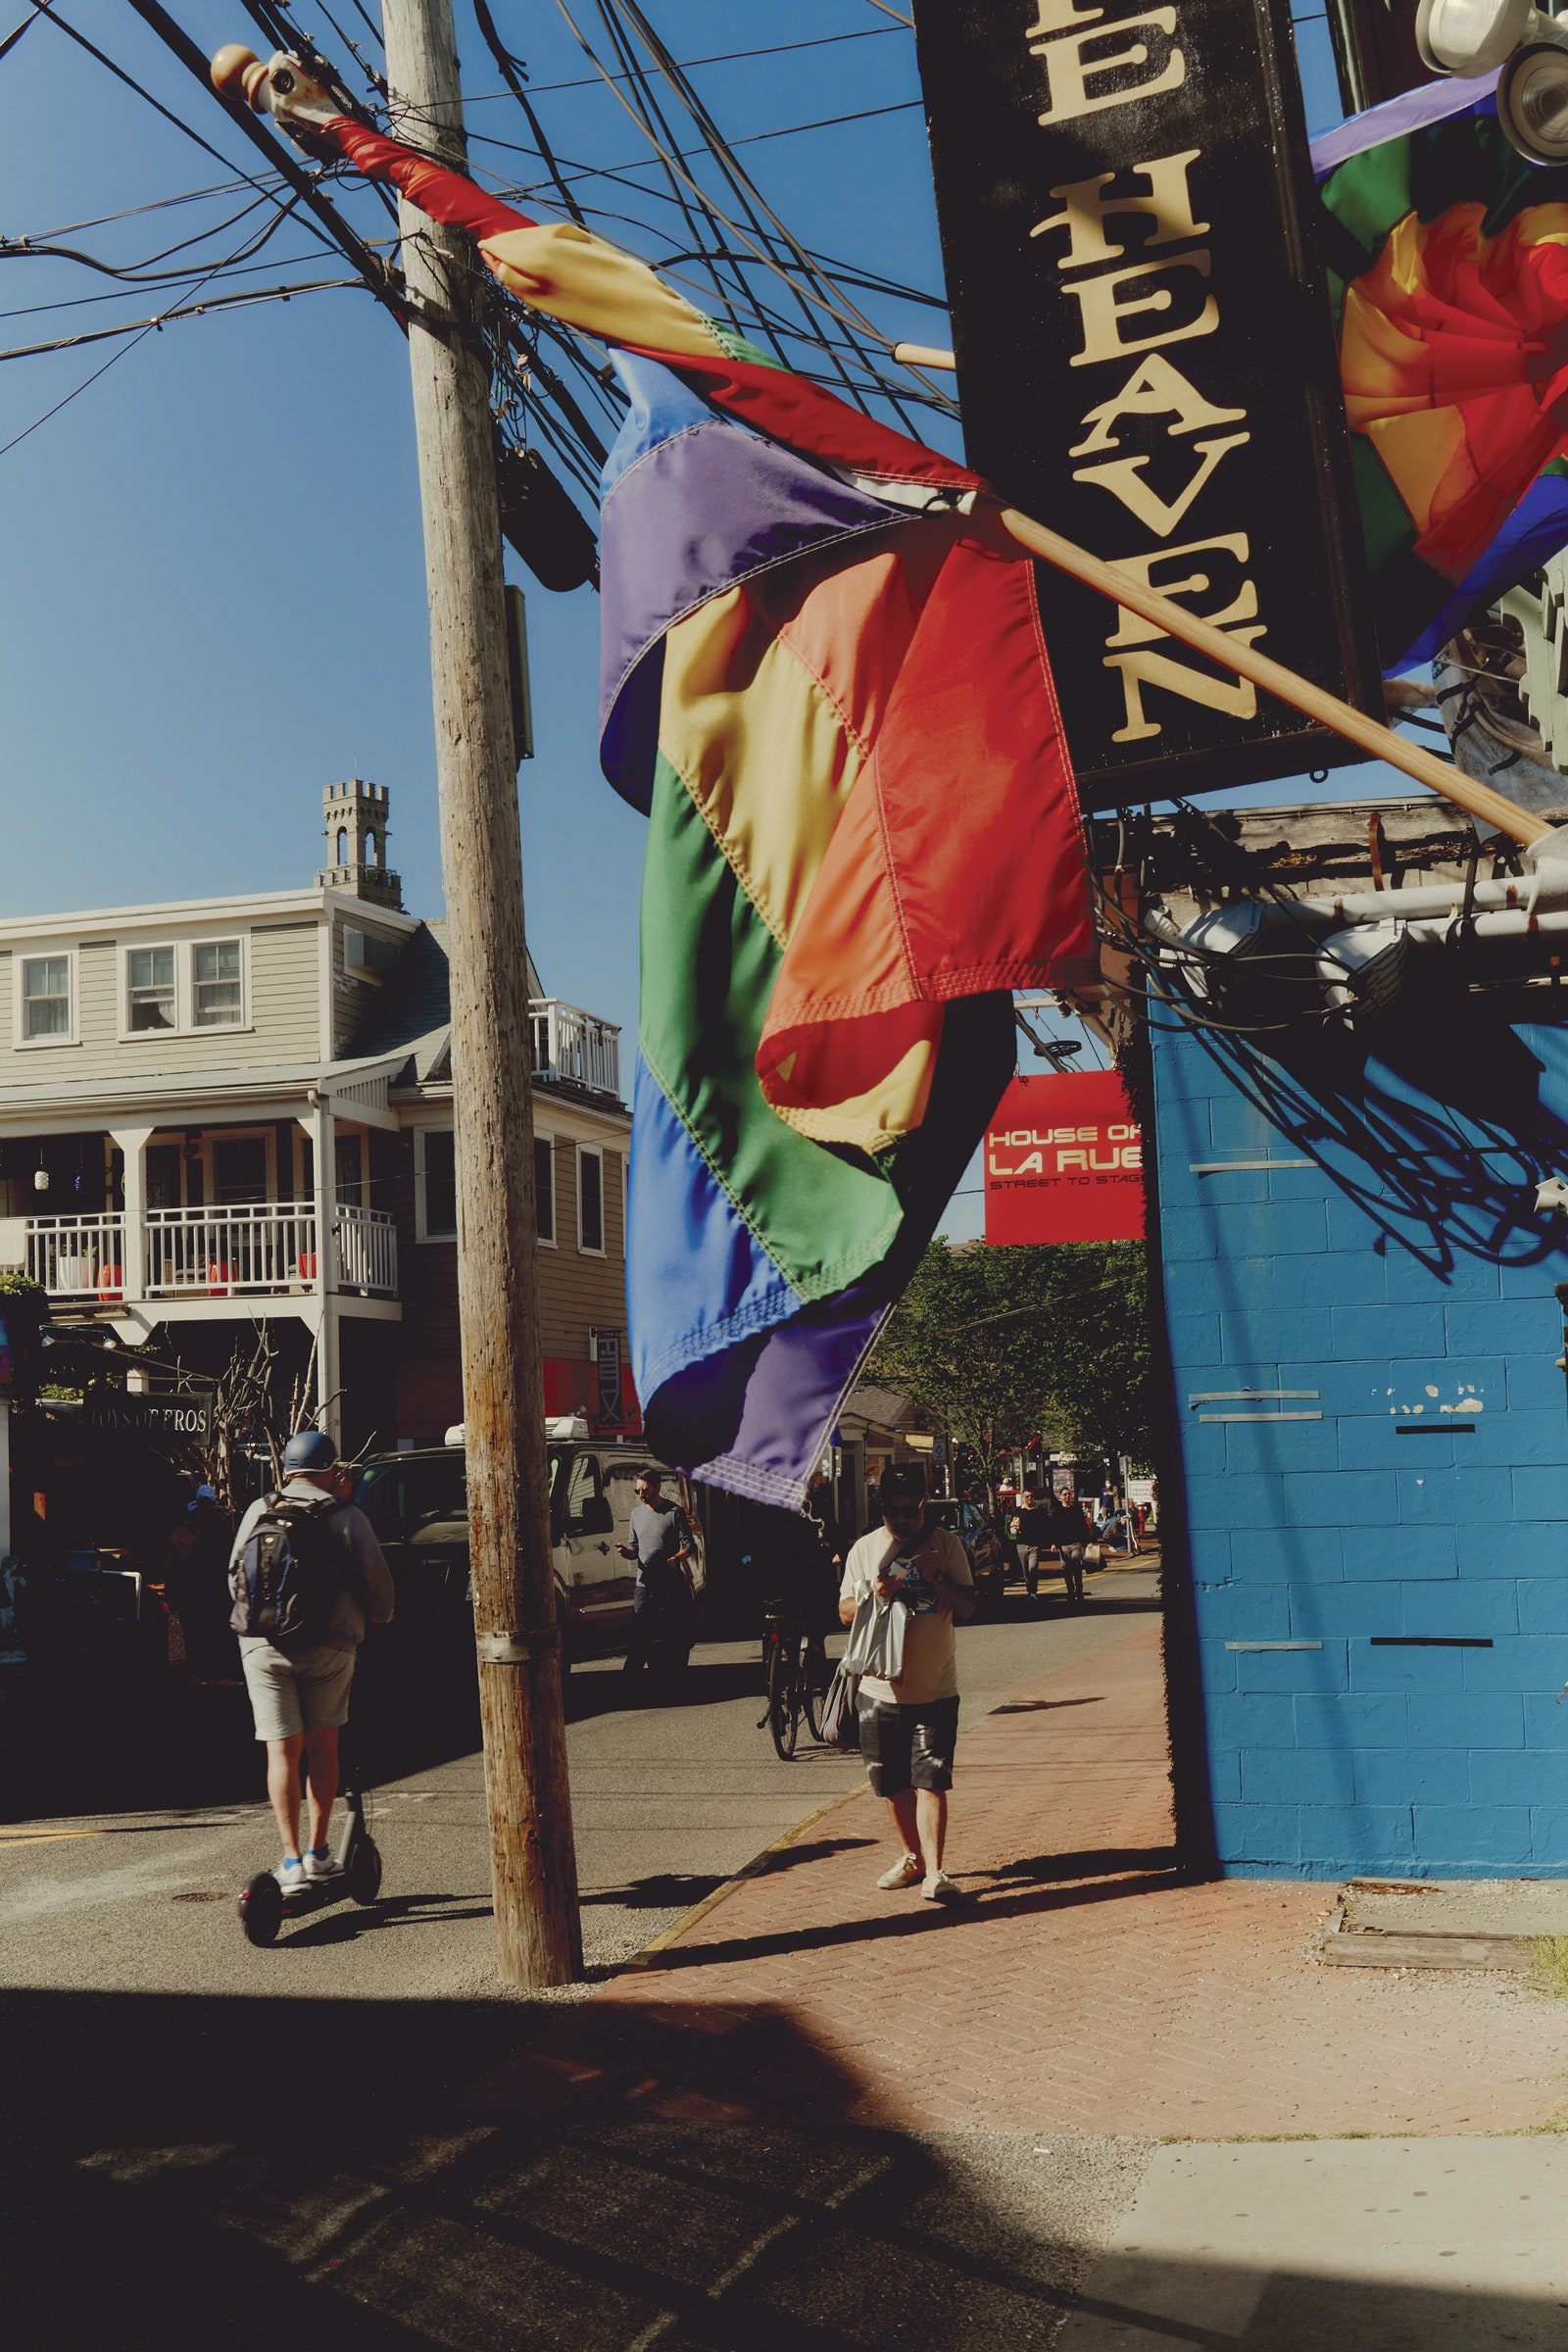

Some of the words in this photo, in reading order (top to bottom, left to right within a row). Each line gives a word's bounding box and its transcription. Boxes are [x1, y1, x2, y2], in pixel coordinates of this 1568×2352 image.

[1025, 0, 1185, 126] E
[1029, 148, 1267, 743] HEAVEN
[989, 1126, 1098, 1148] HOUSE
[989, 1152, 1044, 1175] LA
[1056, 1146, 1144, 1172] RUE
[990, 1178, 1060, 1190] STREET
[1066, 1176, 1091, 1186] TO
[1096, 1174, 1145, 1184] STAG
